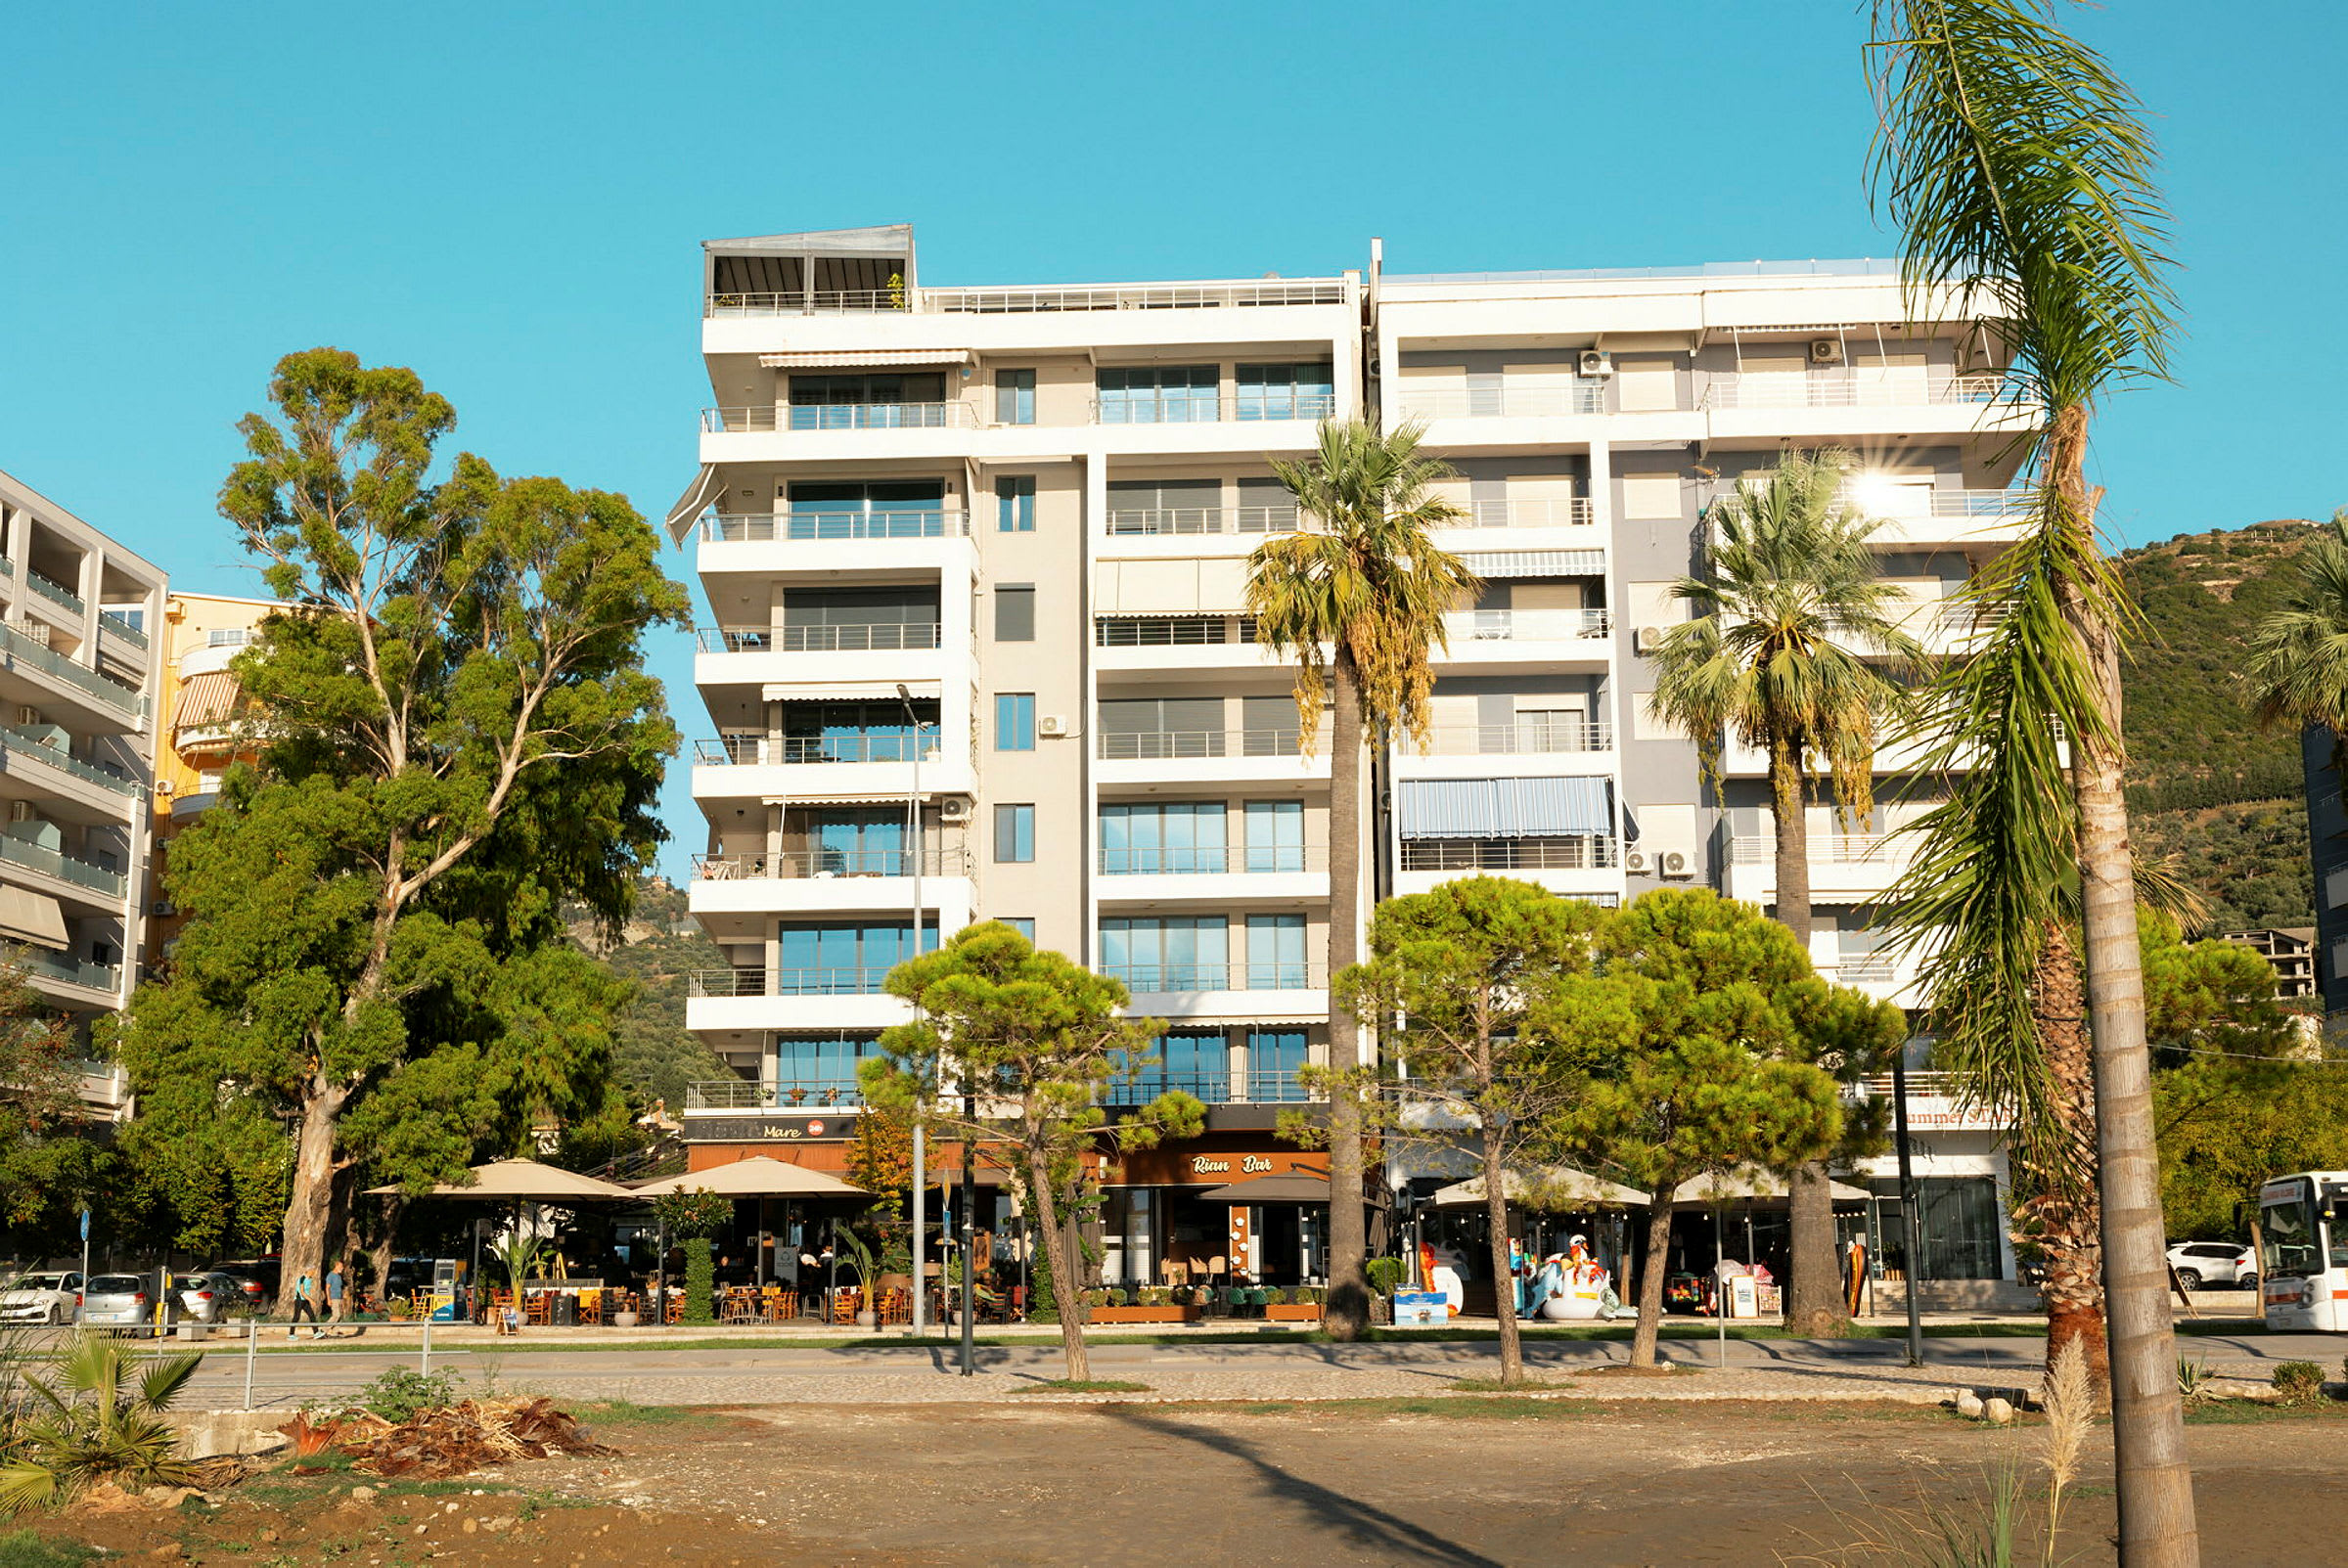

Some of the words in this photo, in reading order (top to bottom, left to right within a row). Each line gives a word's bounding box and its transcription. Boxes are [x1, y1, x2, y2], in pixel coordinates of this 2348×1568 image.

[1906, 1111, 1963, 1124] ummer
[764, 1125, 802, 1138] Mare
[1192, 1156, 1231, 1174] Rian
[1242, 1155, 1273, 1173] Bar
